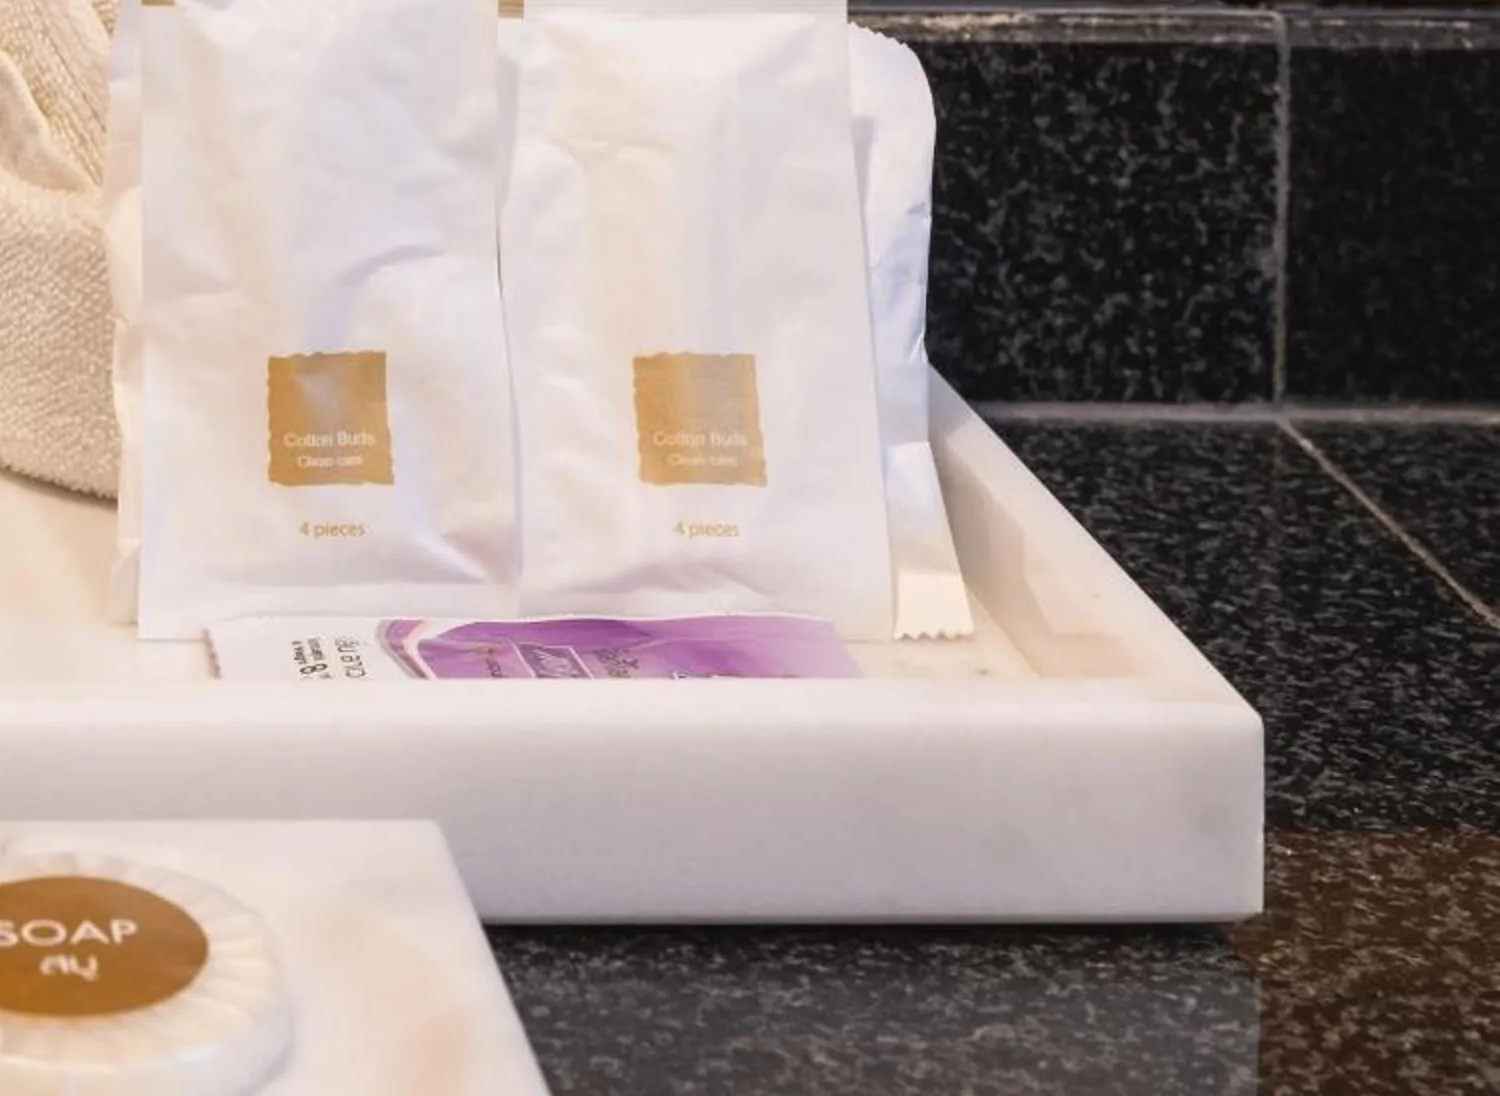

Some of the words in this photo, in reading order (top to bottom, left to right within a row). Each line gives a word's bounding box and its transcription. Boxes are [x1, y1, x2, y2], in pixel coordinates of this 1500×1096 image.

[283, 431, 334, 448] Cotton
[337, 429, 376, 447] Buds
[299, 521, 311, 536] 4
[313, 521, 367, 540] pieces
[687, 521, 740, 539] pieces
